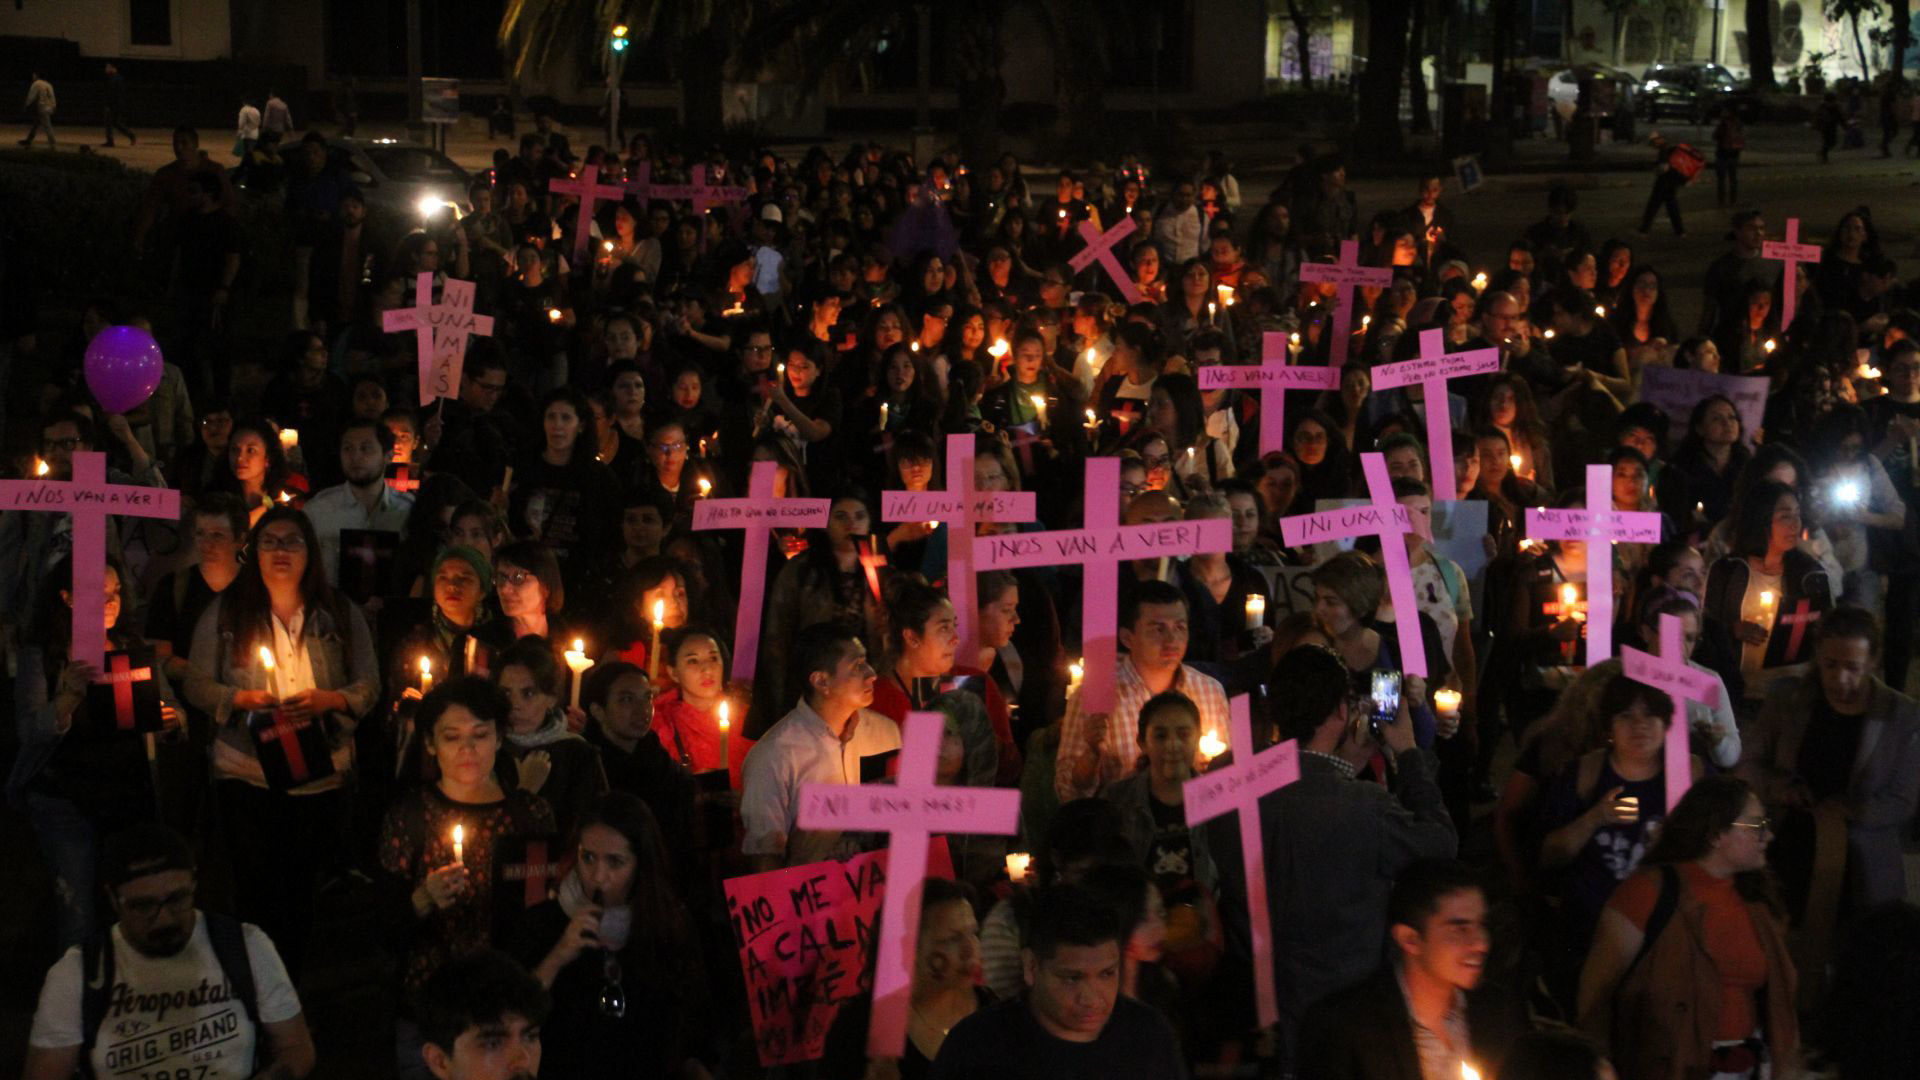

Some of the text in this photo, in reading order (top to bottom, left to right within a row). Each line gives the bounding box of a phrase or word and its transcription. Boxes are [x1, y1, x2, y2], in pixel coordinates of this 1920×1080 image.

[445, 289, 468, 308] NI
[428, 311, 476, 332] UNA
[1244, 370, 1274, 381] VAN
[14, 484, 64, 505] ¡NOS
[73, 489, 105, 503] VAN
[110, 495, 120, 504] A
[888, 495, 917, 518] ¡NI
[926, 502, 964, 515] UNA
[1341, 509, 1384, 527] UNA
[991, 536, 1043, 564] ¡NOS
[1055, 535, 1098, 556] VAN
[1109, 531, 1125, 554] A
[788, 875, 832, 918] ME
[747, 946, 768, 982] A
[106, 1012, 238, 1069] ORIG. BRAND
